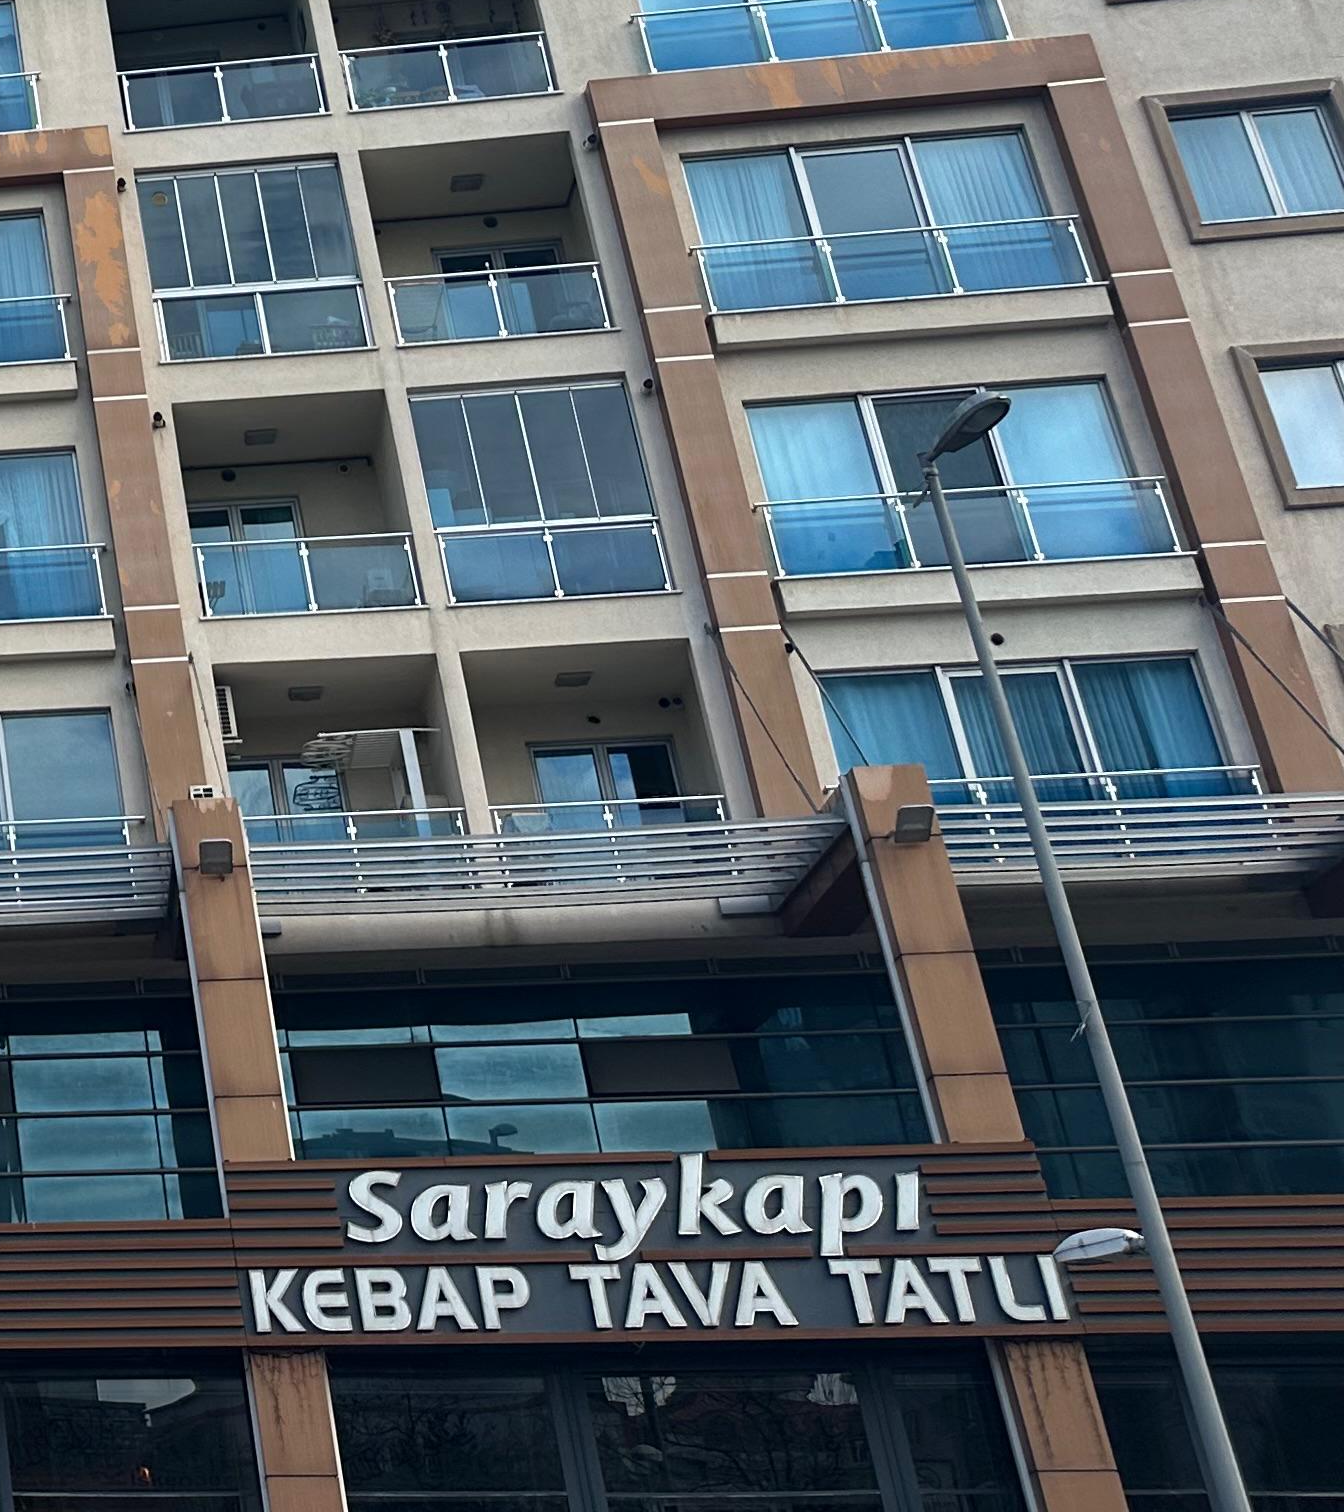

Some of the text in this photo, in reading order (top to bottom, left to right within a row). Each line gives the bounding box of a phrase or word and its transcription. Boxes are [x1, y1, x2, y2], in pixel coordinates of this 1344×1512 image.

[345, 1152, 921, 1262] Saraykapı
[248, 1253, 1071, 1334] KEBAP TAVA TATLI
